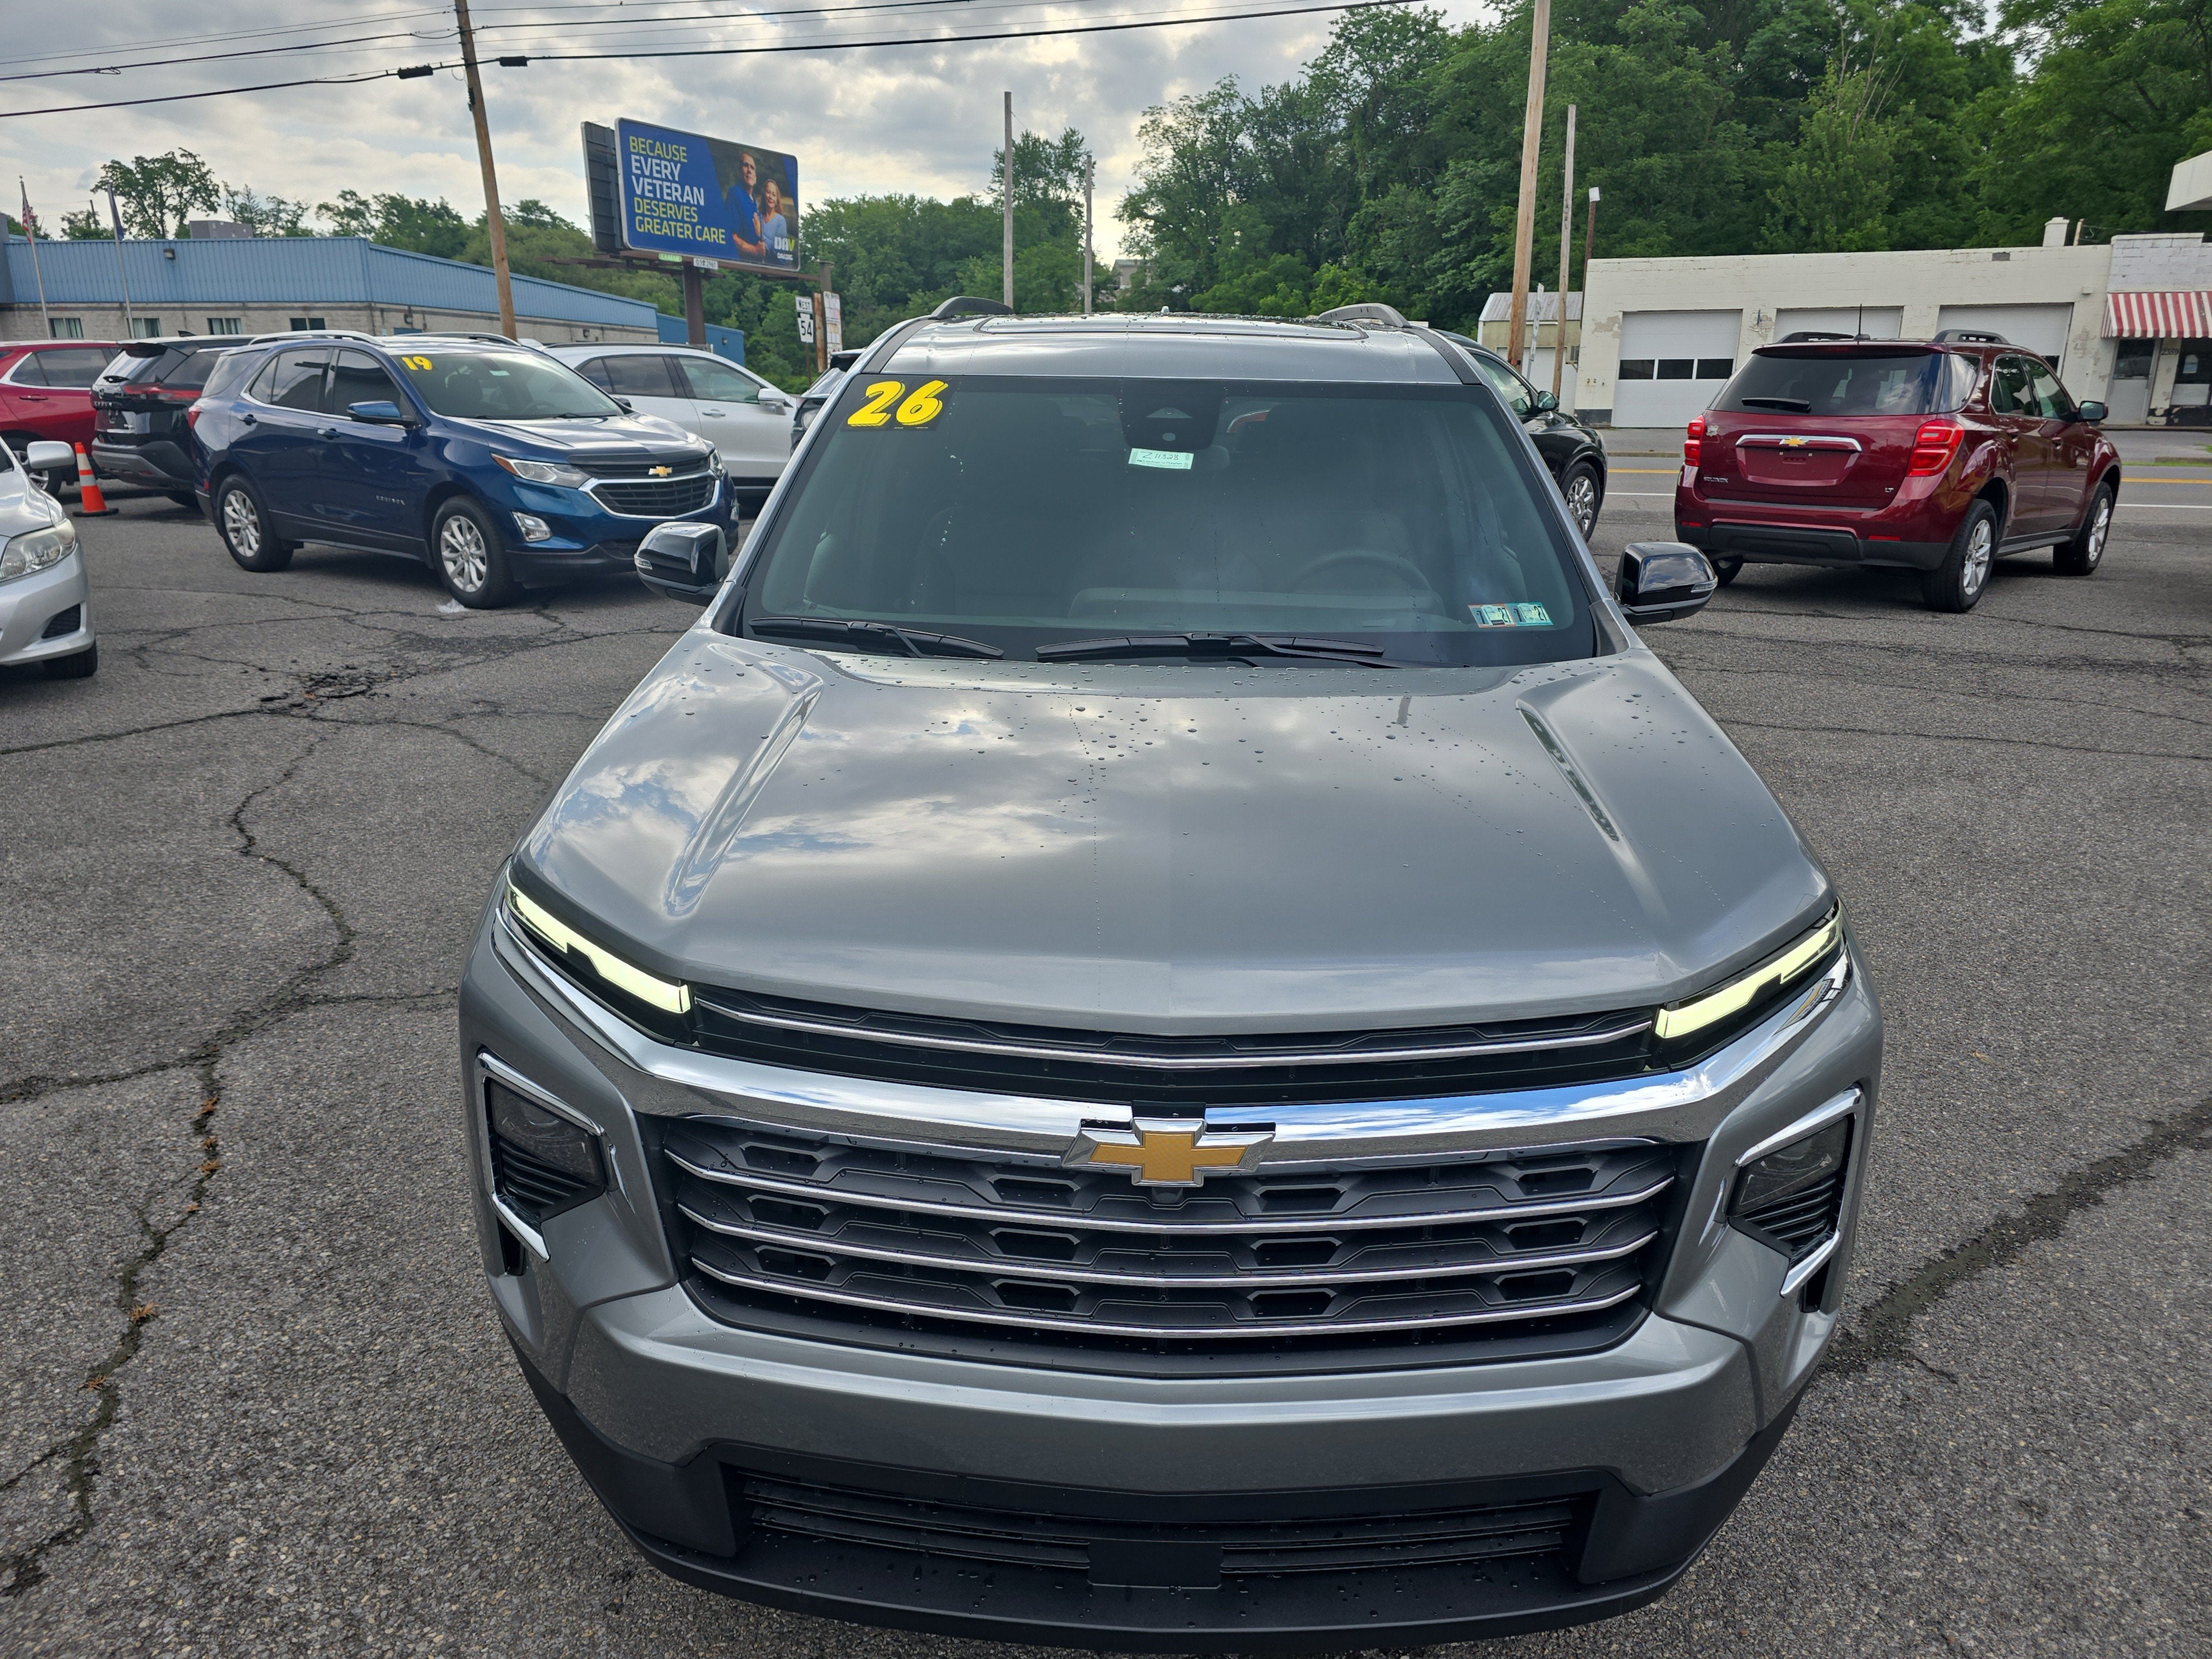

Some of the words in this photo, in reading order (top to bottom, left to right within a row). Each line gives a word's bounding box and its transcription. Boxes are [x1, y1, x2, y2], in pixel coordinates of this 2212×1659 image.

[629, 136, 687, 163] BECAUSE
[631, 154, 681, 181] EVERY
[632, 175, 704, 206] VETERAN
[634, 197, 698, 222] DESERVES
[635, 216, 693, 240] GREATER
[695, 225, 726, 244] CARE
[774, 236, 795, 252] DAV
[798, 299, 811, 310] WEST
[801, 320, 812, 337] 54
[402, 356, 433, 371] 19
[847, 380, 948, 426] 26
[1497, 608, 1511, 623] 27
[1534, 606, 1547, 621] 27
